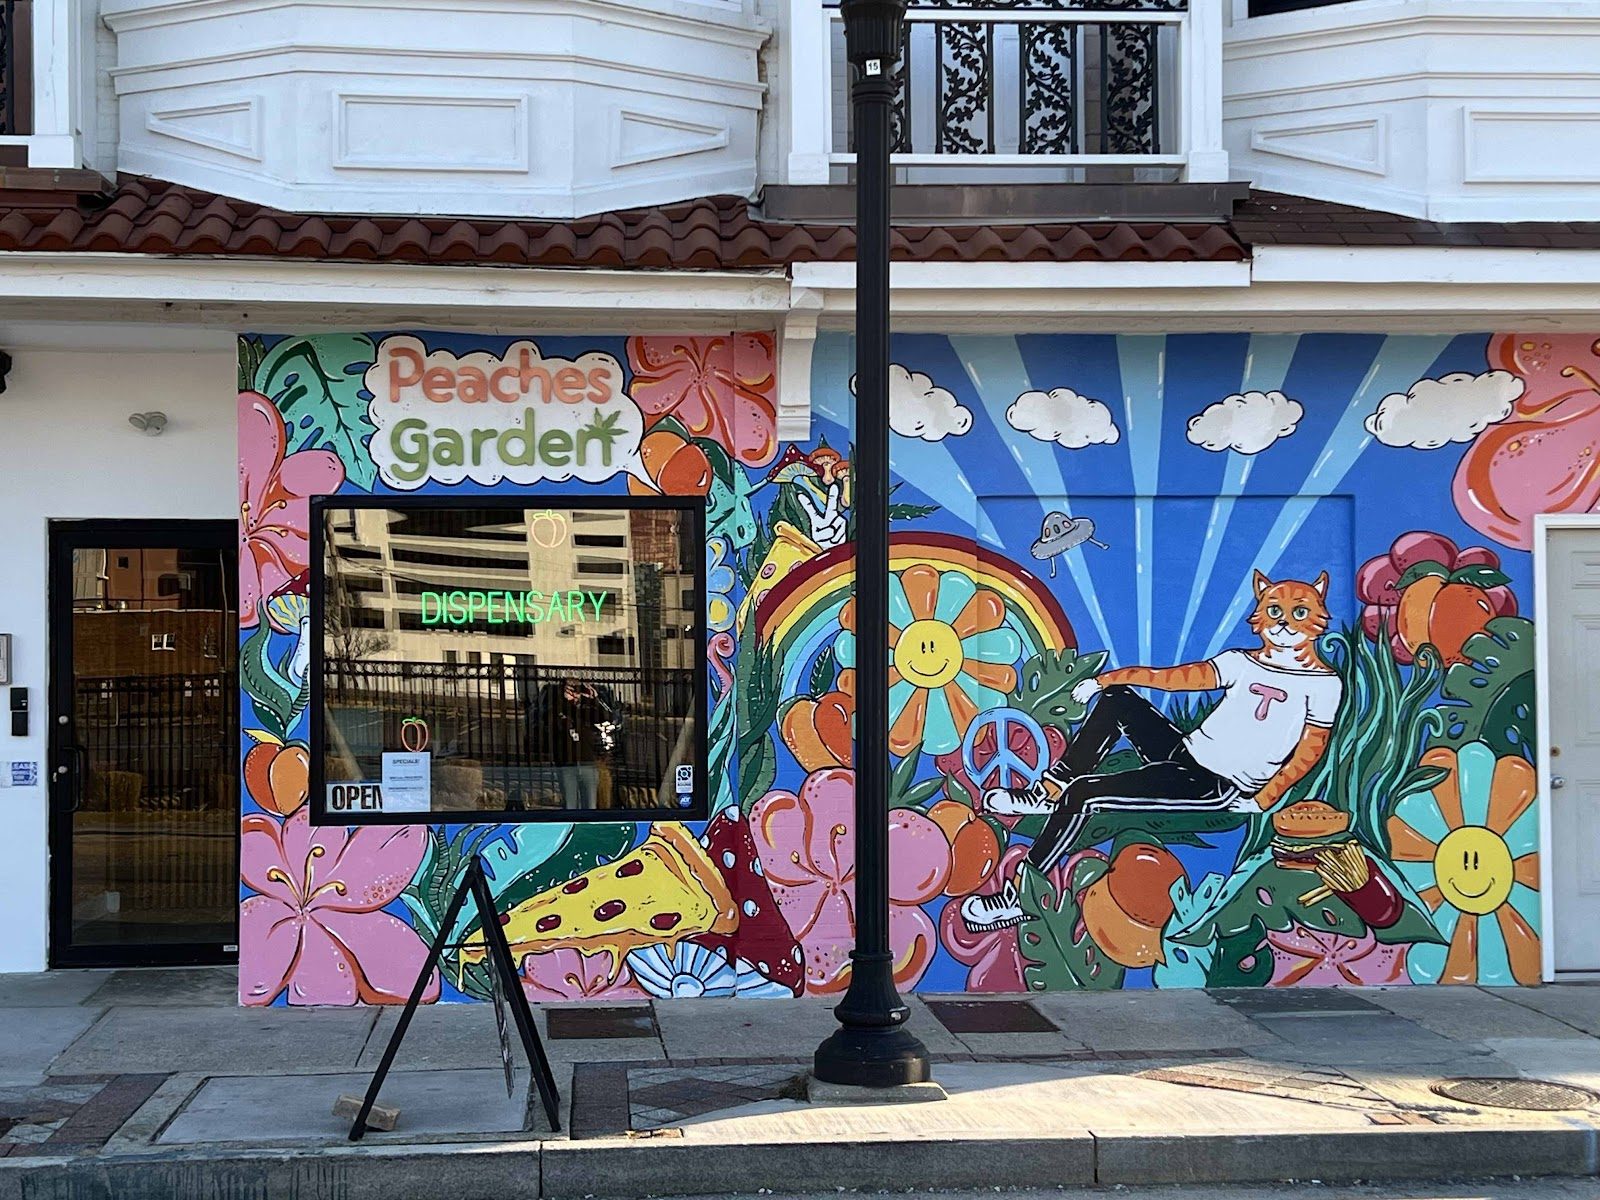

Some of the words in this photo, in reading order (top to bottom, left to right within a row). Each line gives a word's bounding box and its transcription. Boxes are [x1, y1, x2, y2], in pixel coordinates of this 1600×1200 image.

[389, 347, 612, 403] Peaches
[421, 591, 607, 624] DISPENSARY
[1249, 683, 1288, 721] T
